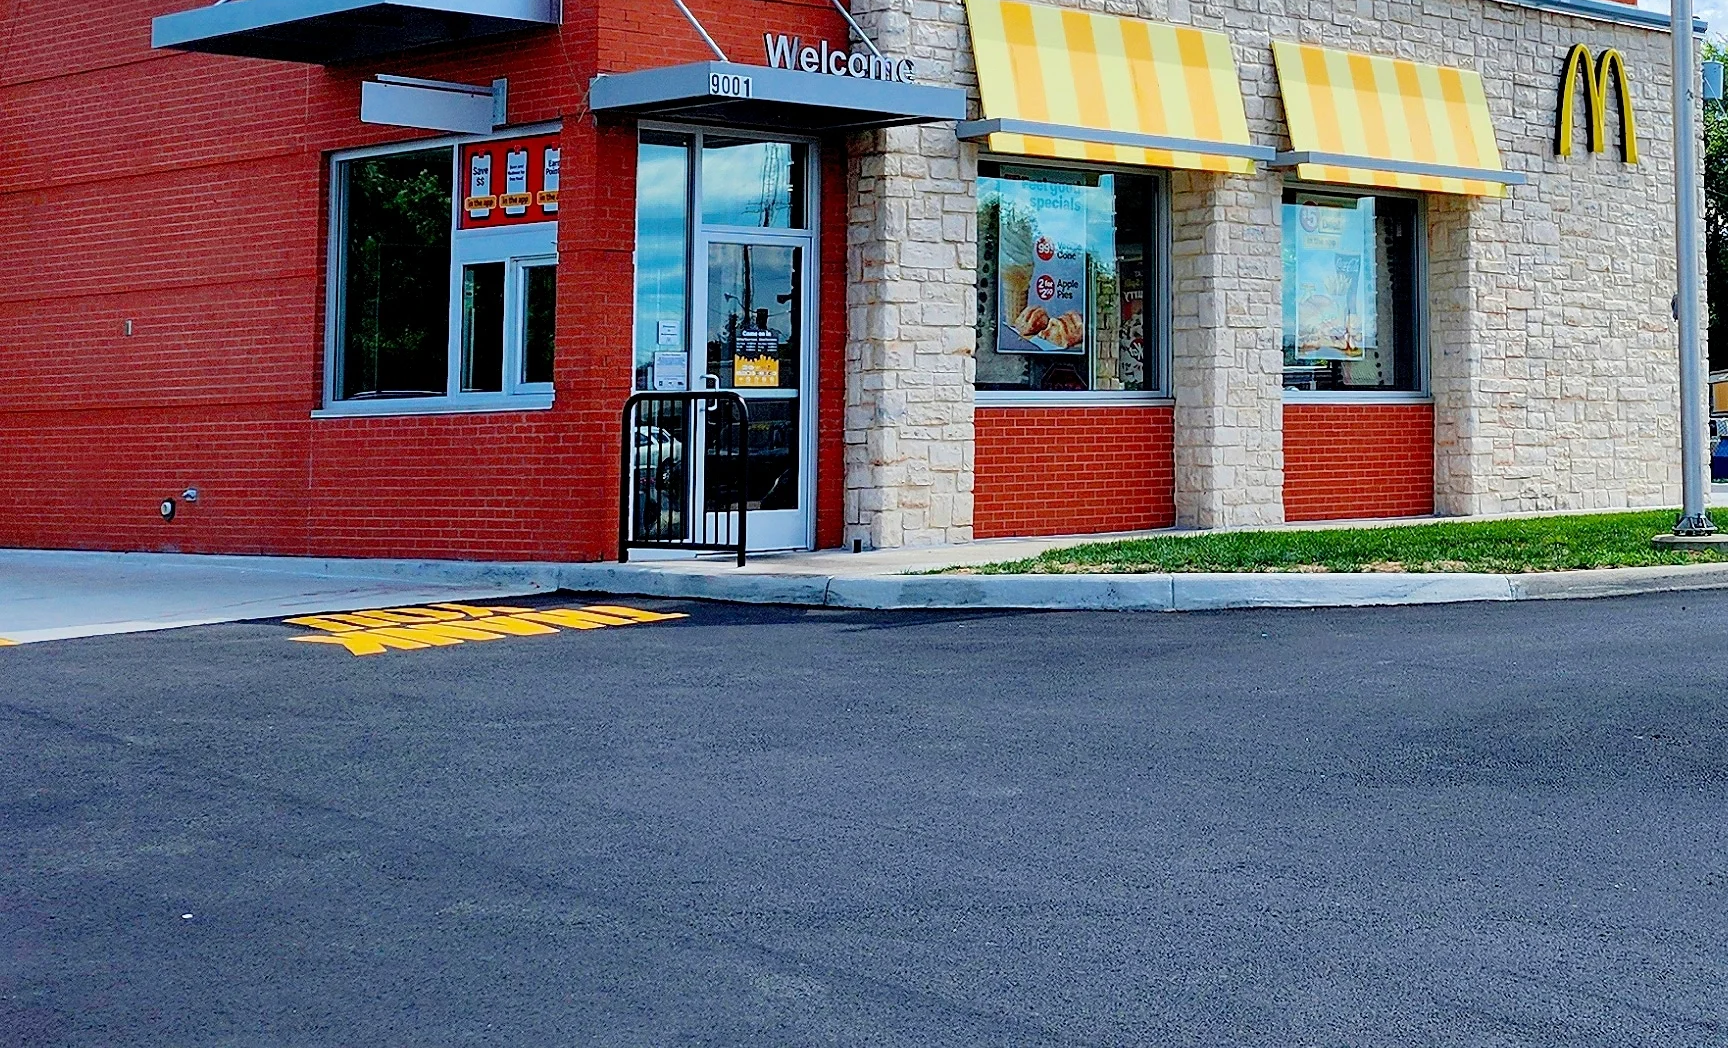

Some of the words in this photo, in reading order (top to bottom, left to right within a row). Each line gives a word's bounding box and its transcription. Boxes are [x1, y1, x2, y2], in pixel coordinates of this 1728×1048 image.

[764, 33, 917, 84] Welcome
[711, 73, 752, 98] 9001
[473, 166, 489, 176] Save
[1030, 195, 1081, 211] specials
[1057, 279, 1079, 291] Apple
[1057, 290, 1073, 299] Pies
